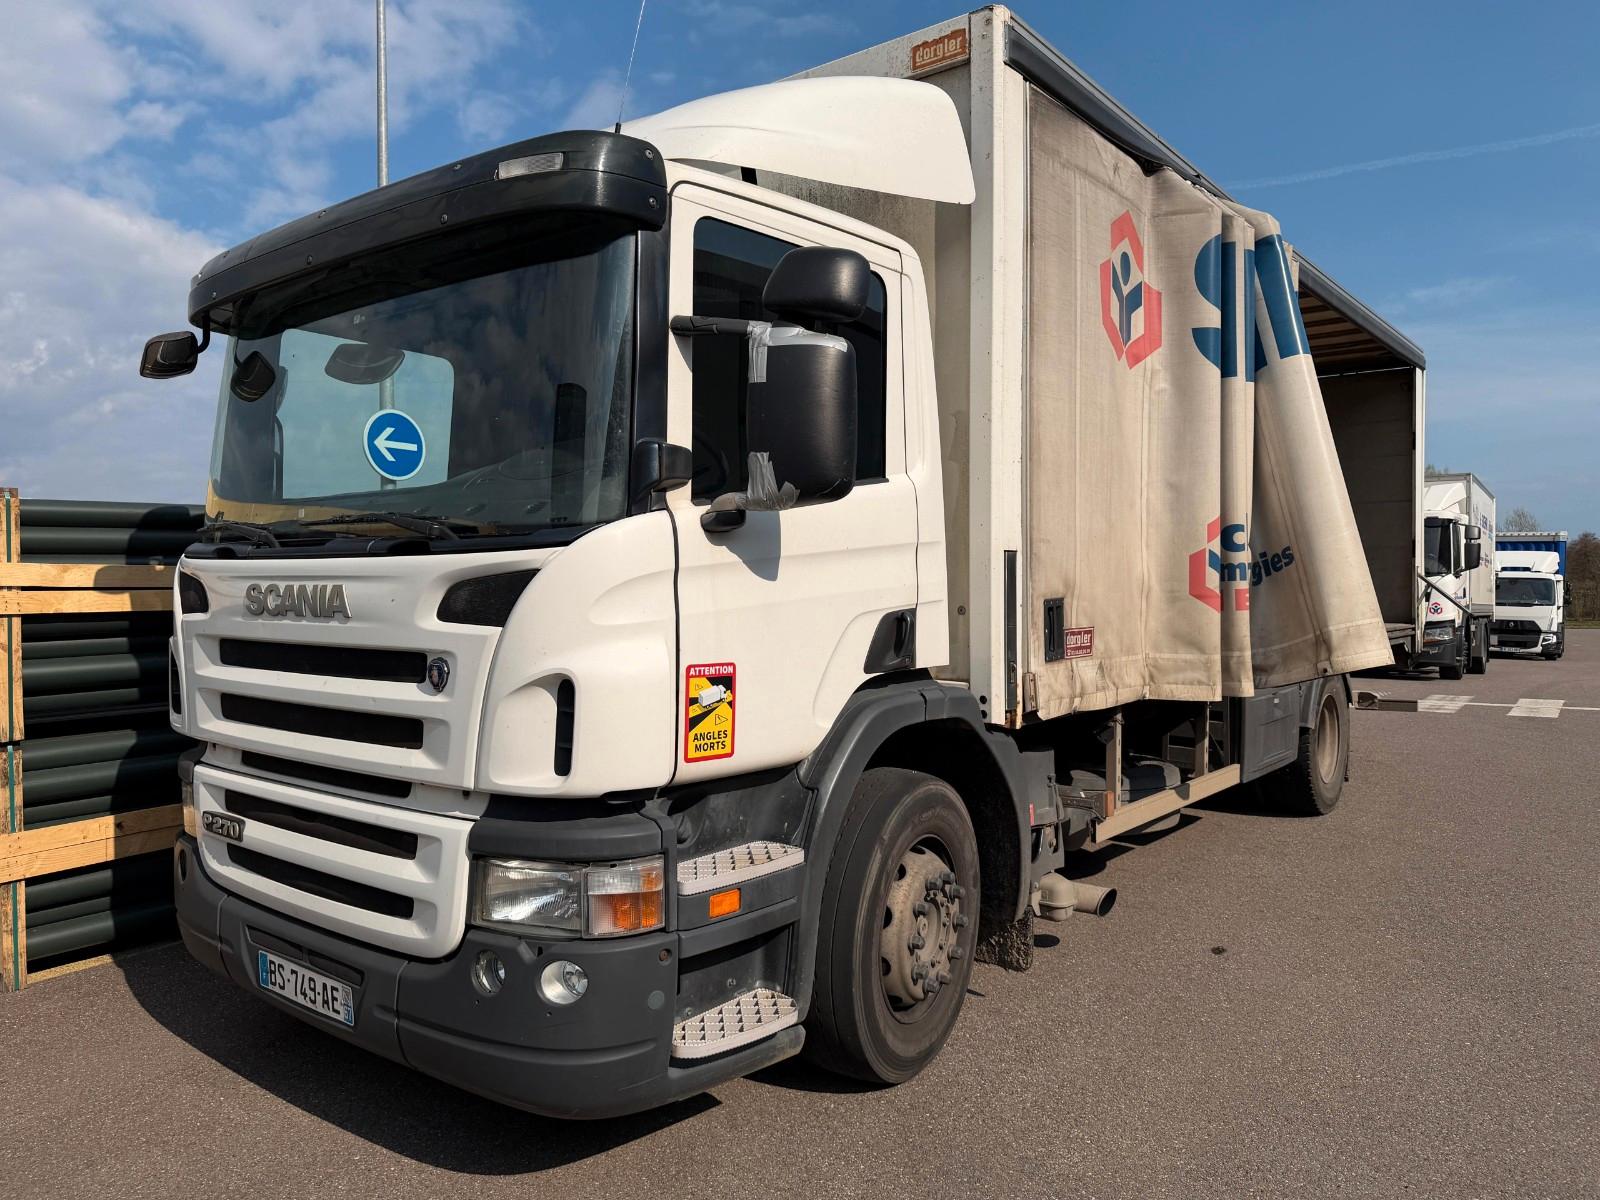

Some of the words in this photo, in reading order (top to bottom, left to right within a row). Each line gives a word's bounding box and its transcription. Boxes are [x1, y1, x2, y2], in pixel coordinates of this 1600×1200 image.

[915, 36, 963, 63] dorgler
[245, 583, 352, 619] SCANIA
[689, 665, 734, 676] ATTENTION
[692, 729, 728, 743] ANGLES
[694, 740, 726, 753] MORTS
